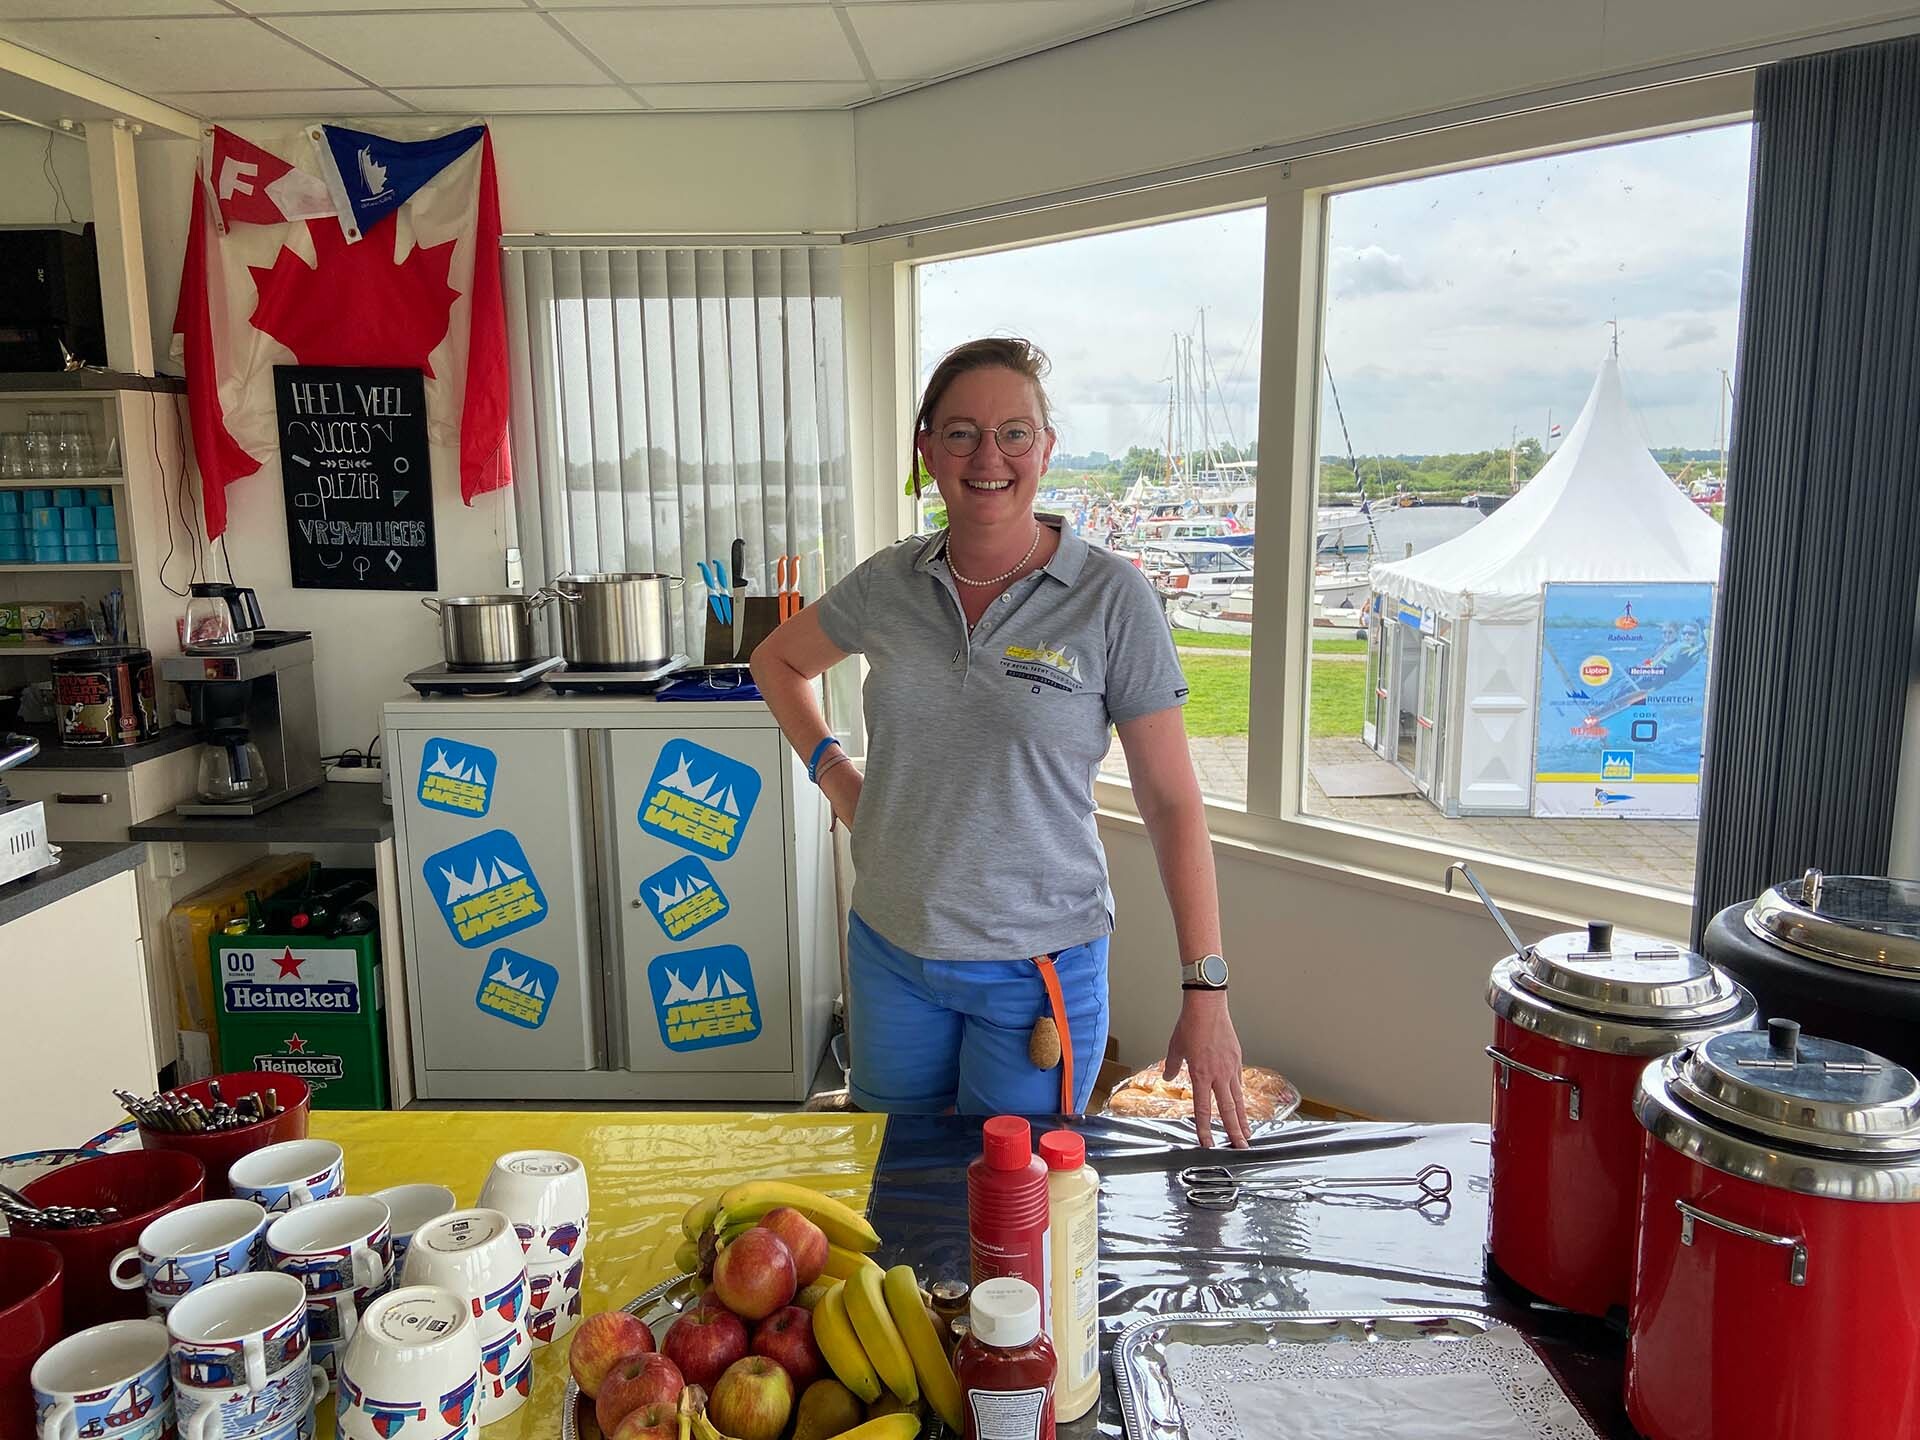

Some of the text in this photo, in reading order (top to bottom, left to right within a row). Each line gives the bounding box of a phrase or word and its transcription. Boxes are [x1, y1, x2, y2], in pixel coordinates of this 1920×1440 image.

[218, 155, 258, 200] F
[291, 383, 411, 416] HEEL VEEL
[311, 421, 372, 453] SUCCES
[338, 459, 354, 469] EN
[1607, 634, 1643, 642] Rabobank
[1585, 667, 1608, 675] Lipton
[1630, 667, 1665, 675] Heineken
[1647, 696, 1694, 704] RIVERTECH
[643, 804, 733, 854] WEEK
[457, 894, 543, 941] WEEK
[227, 953, 255, 972] 0.0
[232, 987, 351, 1008] Heineken
[667, 1013, 757, 1044] WEEK
[260, 1060, 337, 1074] Heineken
